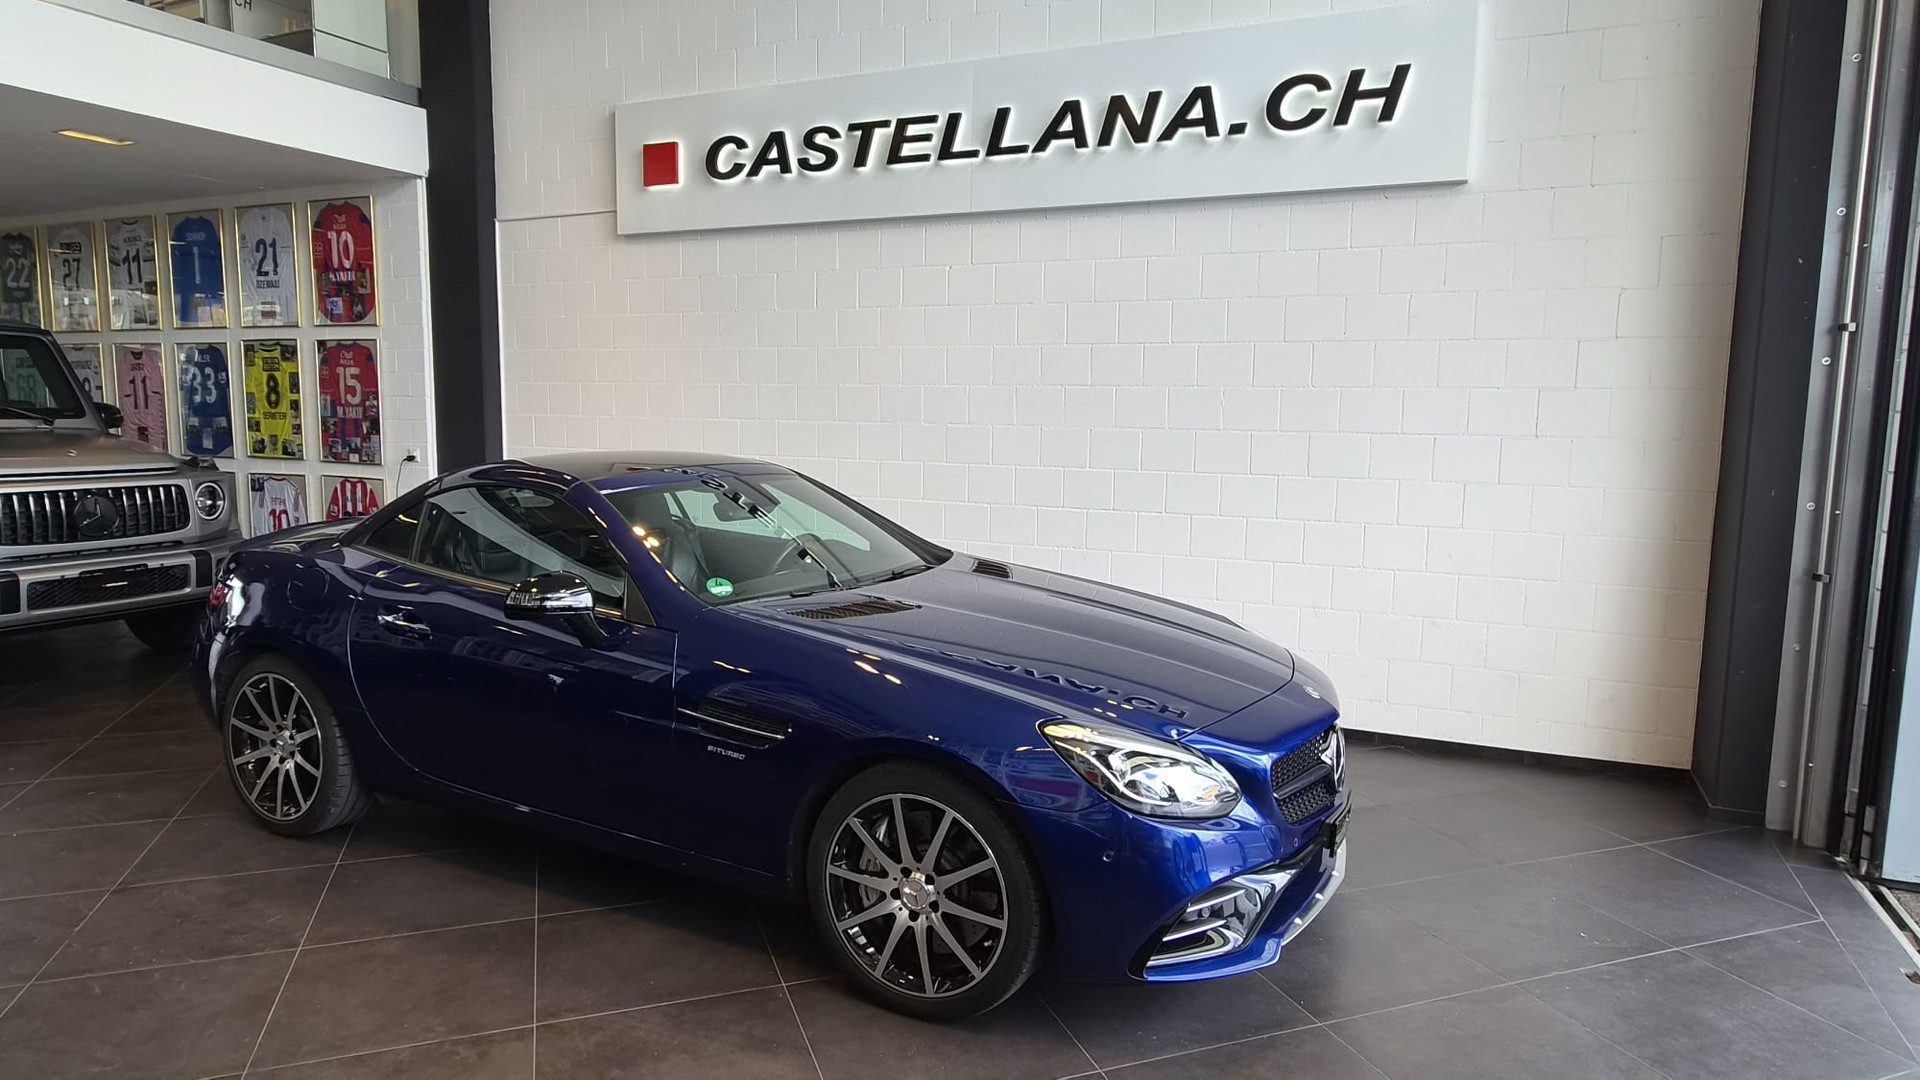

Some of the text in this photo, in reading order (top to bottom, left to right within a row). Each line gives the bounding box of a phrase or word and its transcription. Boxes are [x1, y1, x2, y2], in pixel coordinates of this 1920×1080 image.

[122, 248, 142, 285] 11
[192, 247, 201, 284] 1
[255, 238, 278, 276] 21
[328, 231, 354, 269] 10
[6, 257, 30, 288] 22
[62, 258, 80, 291] 27
[129, 375, 149, 410] 11
[191, 366, 217, 404] 33
[265, 372, 280, 410] 8
[336, 367, 362, 406] 15
[707, 745, 746, 760] BITURBO
